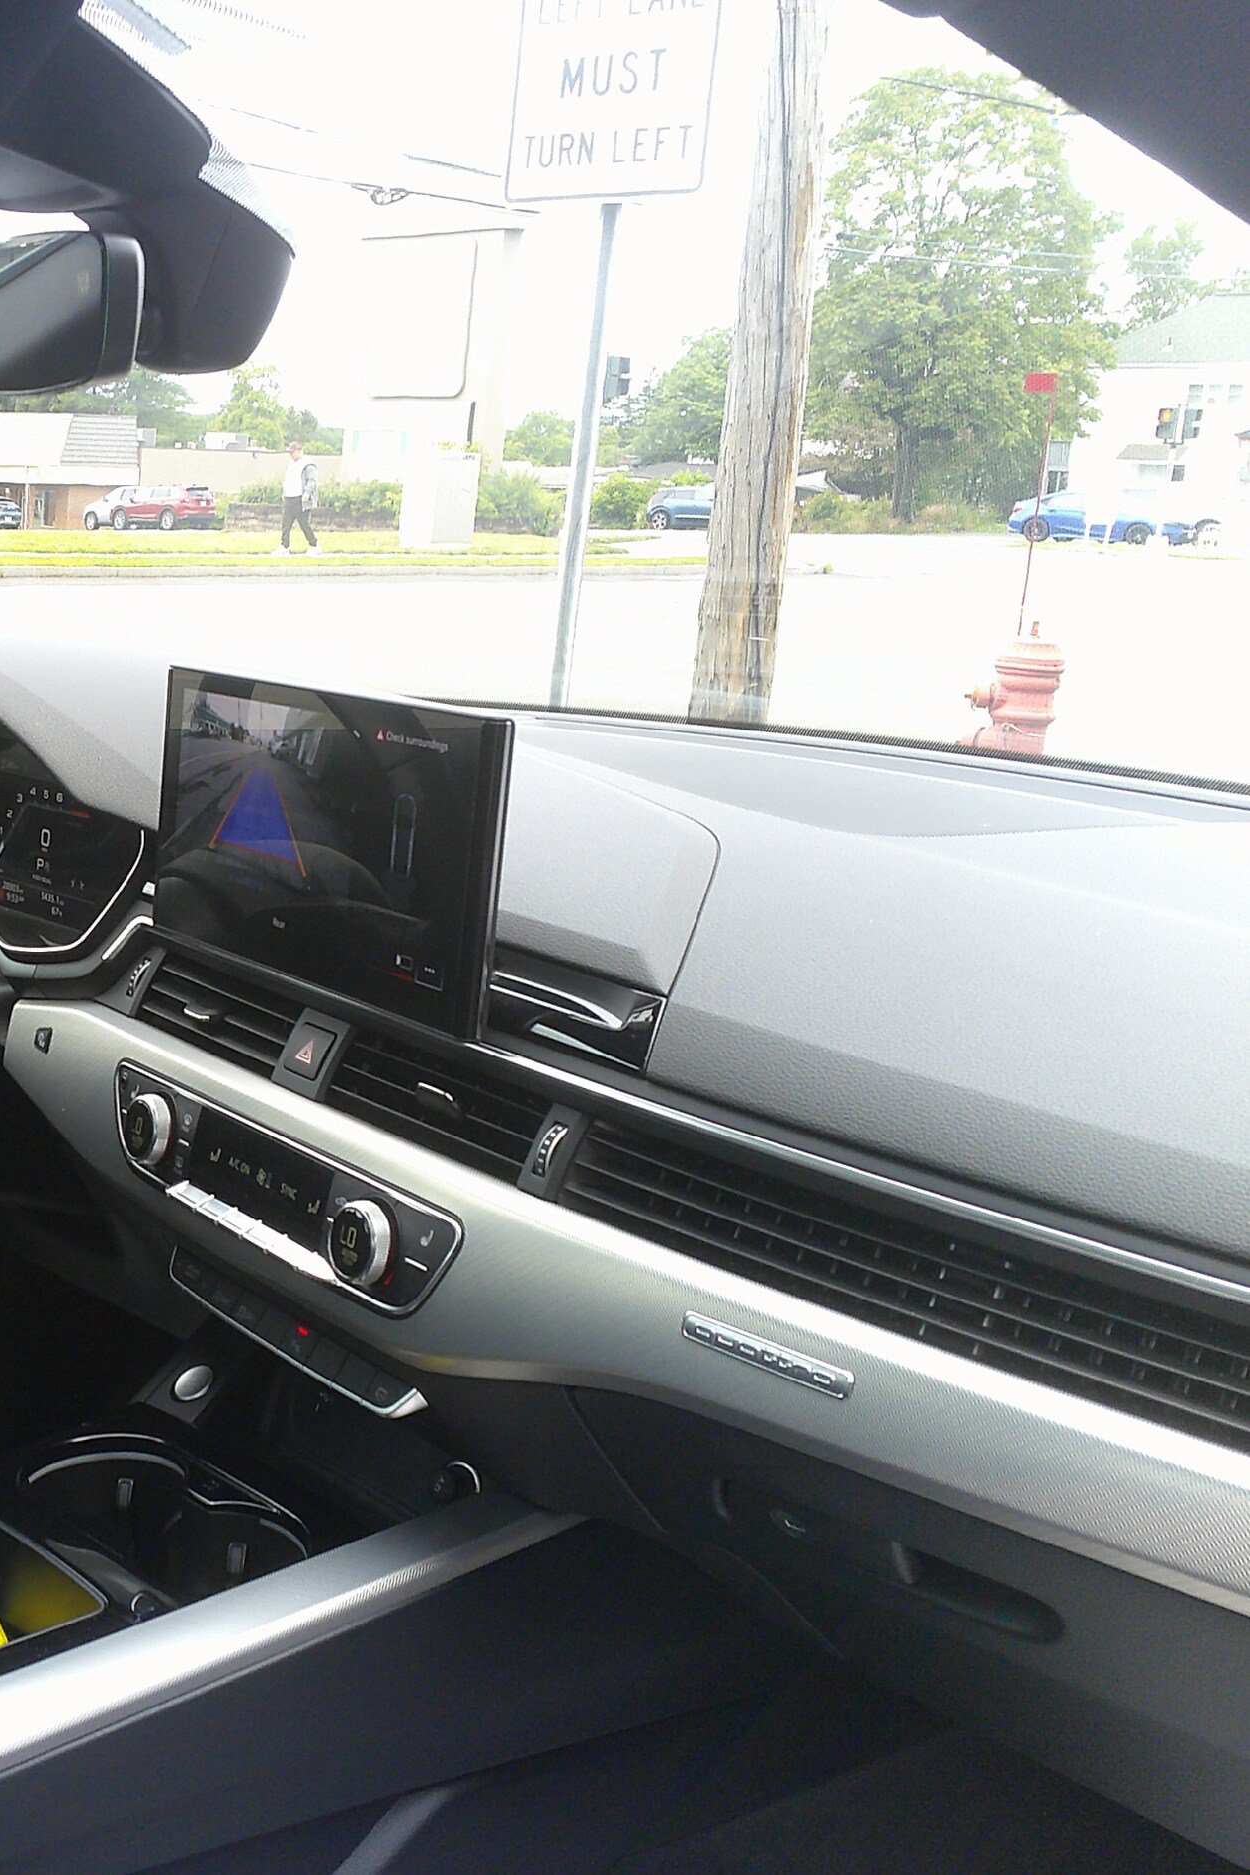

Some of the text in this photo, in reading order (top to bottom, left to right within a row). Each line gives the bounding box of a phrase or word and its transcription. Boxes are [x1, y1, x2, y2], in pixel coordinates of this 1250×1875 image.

[560, 48, 667, 98] MUST
[525, 125, 693, 168] TURN LEFT
